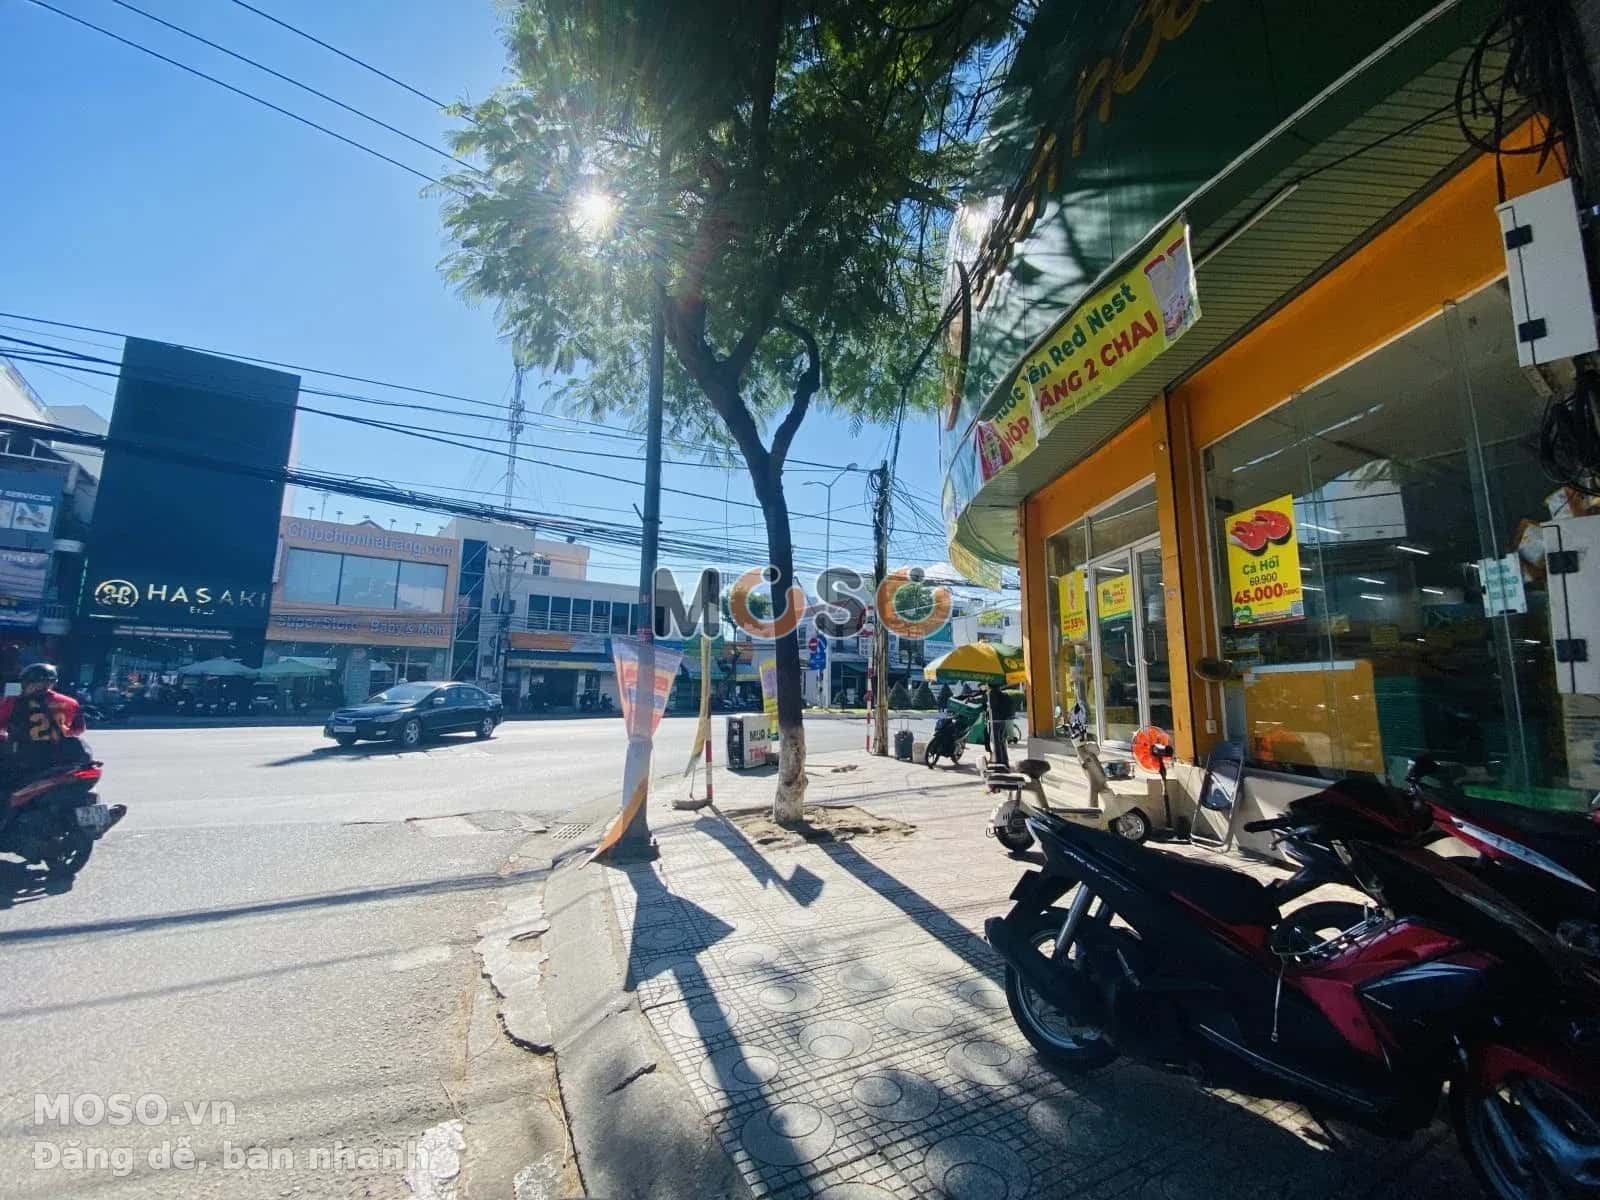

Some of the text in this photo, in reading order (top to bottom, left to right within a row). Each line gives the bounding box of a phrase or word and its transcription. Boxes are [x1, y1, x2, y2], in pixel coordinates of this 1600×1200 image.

[1048, 323, 1087, 366] Red
[1086, 282, 1137, 336] Nest
[1083, 358, 1100, 381] 2
[1100, 309, 1159, 367] CHAI
[148, 583, 266, 609] HASAKI
